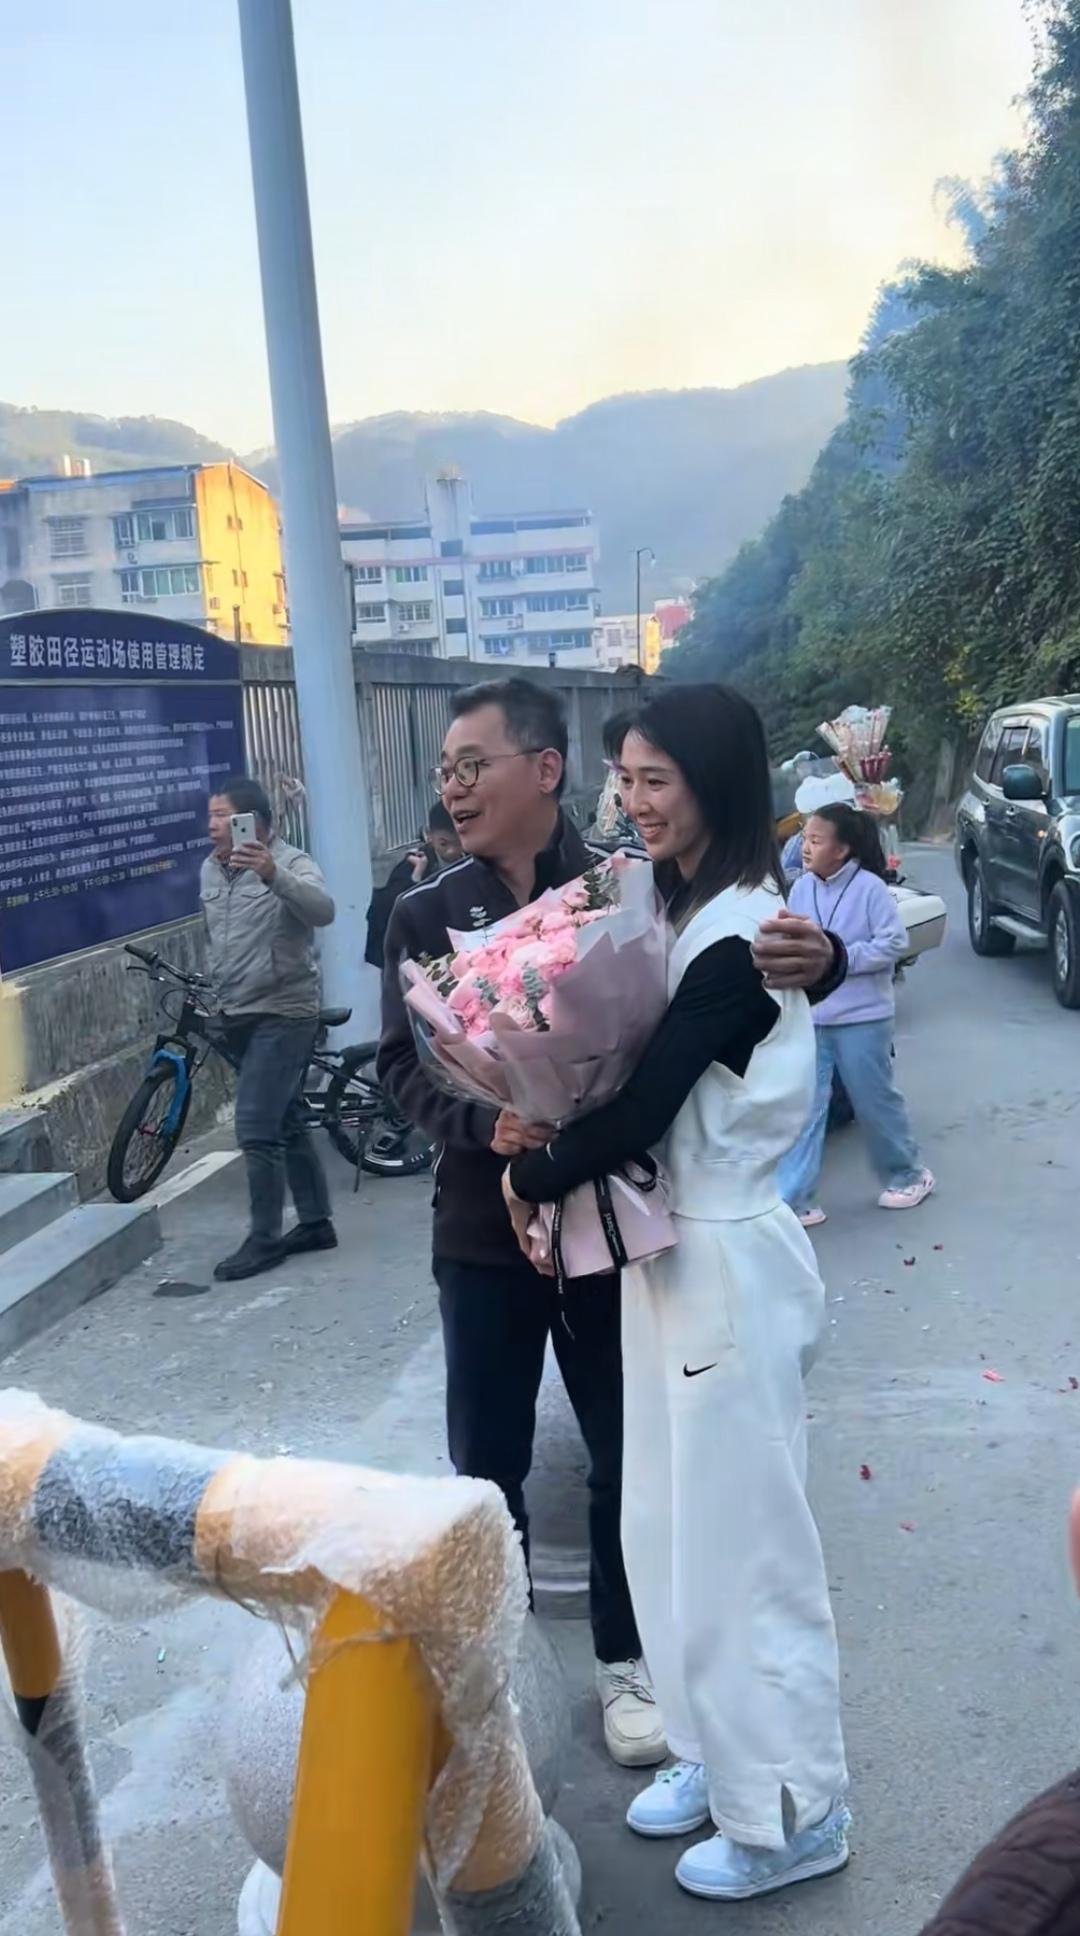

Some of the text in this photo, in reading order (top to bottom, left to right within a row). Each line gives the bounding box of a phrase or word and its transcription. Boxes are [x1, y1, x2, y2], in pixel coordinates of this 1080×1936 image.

[10, 633, 205, 670] 塑胶田径运动场使用管理规定
